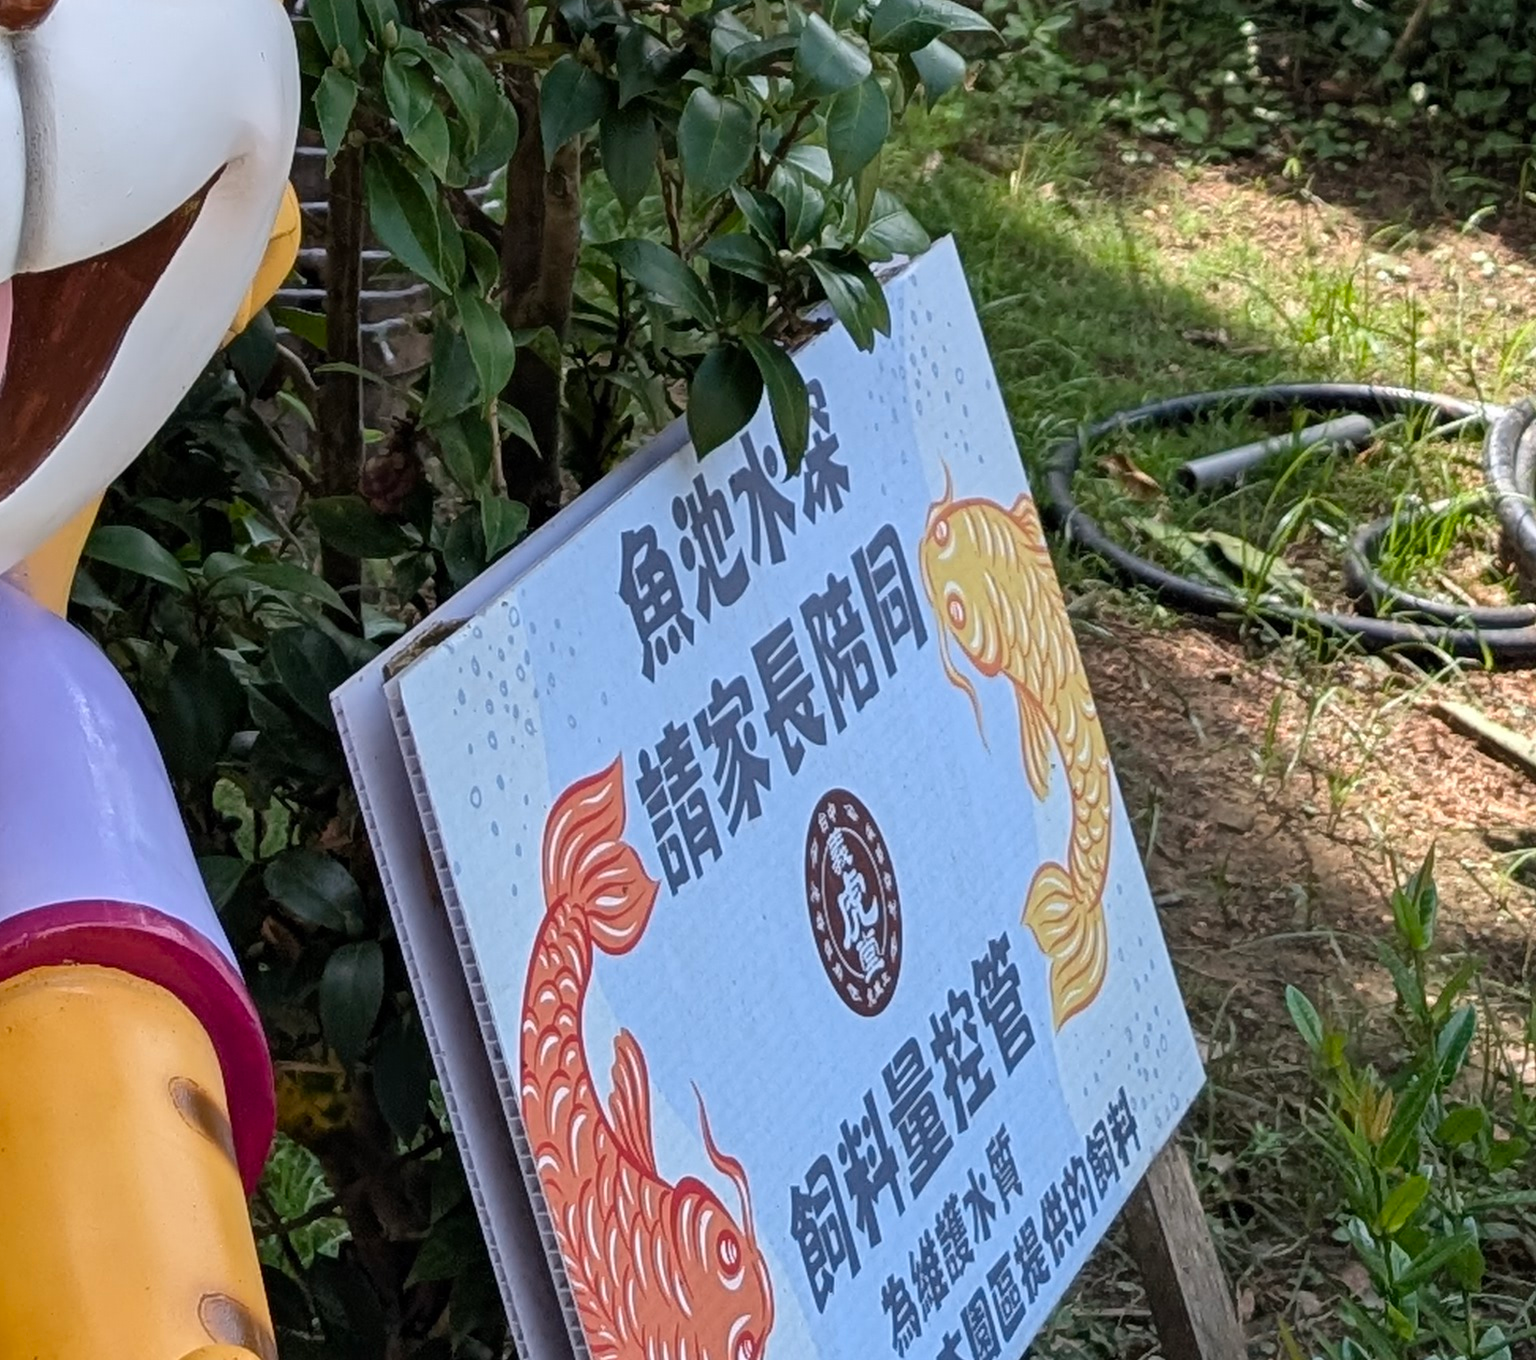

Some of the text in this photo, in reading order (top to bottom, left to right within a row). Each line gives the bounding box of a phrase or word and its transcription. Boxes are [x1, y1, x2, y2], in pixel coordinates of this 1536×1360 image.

[634, 522, 929, 897] 請家長陪同
[790, 930, 1036, 1315] 飼料量控管
[880, 1122, 1024, 1358] 為維護水質
